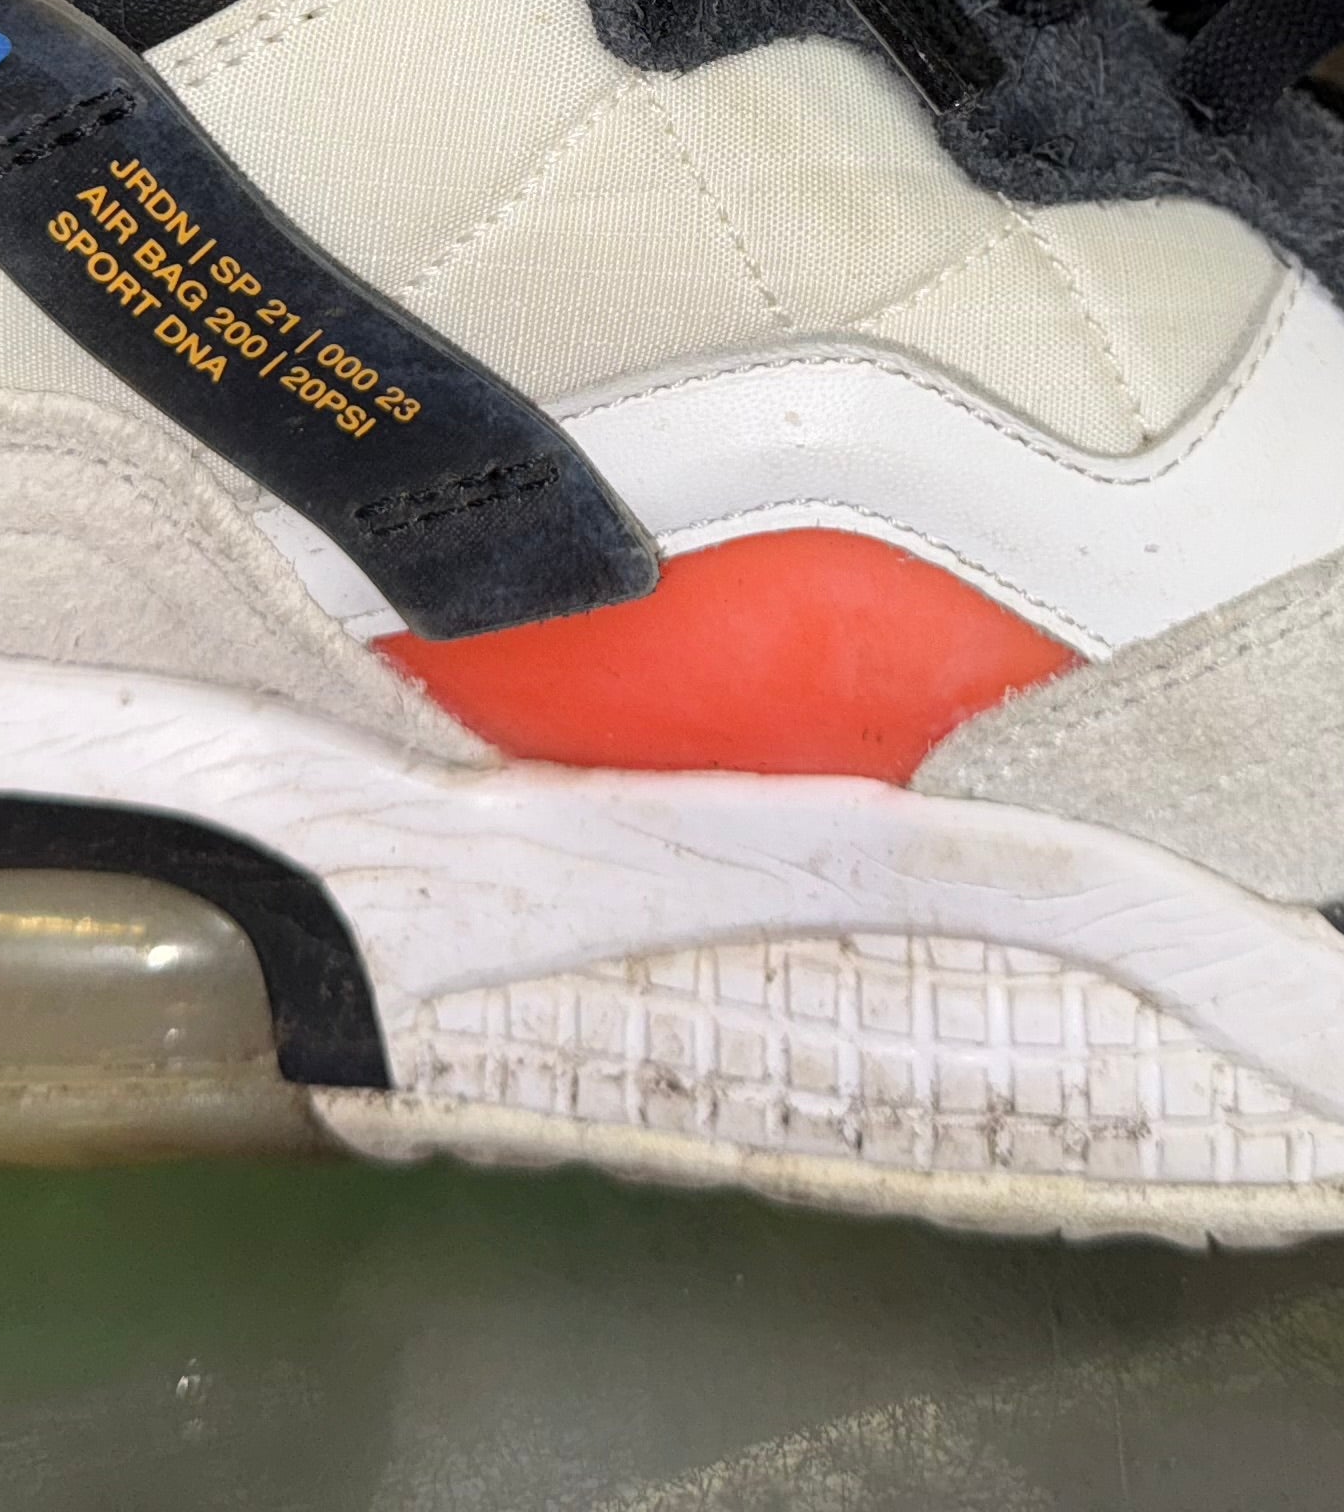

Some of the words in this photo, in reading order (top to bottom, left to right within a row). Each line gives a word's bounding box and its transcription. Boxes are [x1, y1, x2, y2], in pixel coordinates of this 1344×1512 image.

[48, 211, 161, 318] SPORT
[154, 315, 229, 384] DNA
[76, 185, 139, 246] AIR
[133, 239, 209, 313] BAG
[205, 307, 269, 360] 200
[280, 366, 377, 439] 20PSI
[111, 159, 201, 246] JRDN
[211, 256, 263, 297] SP
[257, 299, 301, 335] 21
[317, 344, 379, 392] 000
[375, 387, 422, 424] 23
